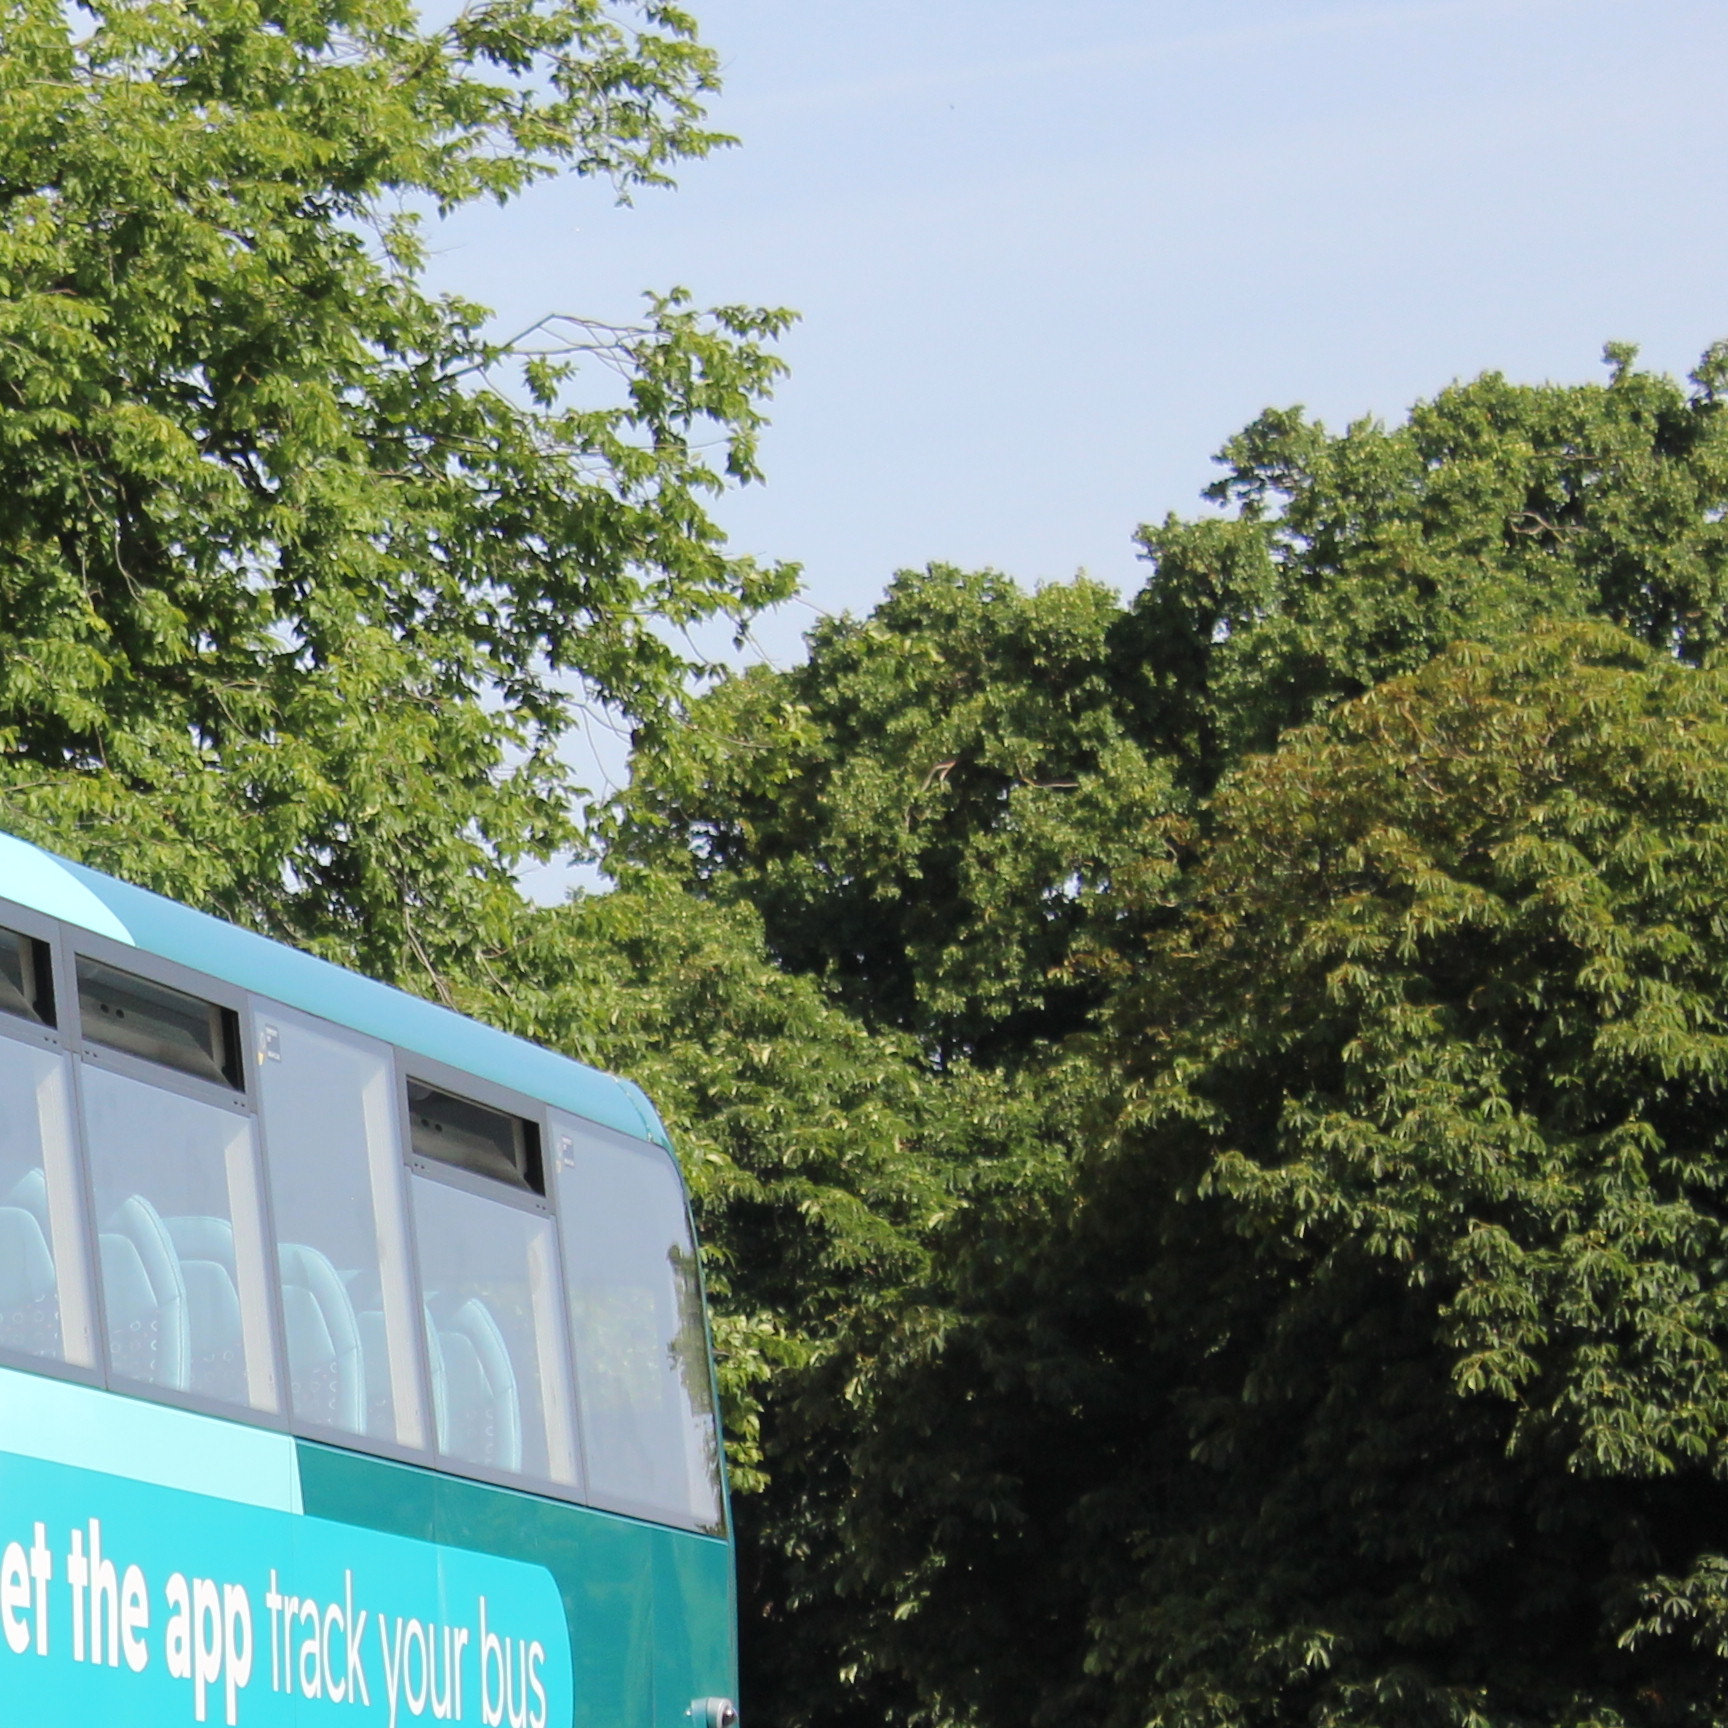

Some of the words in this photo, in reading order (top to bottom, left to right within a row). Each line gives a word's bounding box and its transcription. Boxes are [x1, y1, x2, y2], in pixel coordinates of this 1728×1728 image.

[67, 1516, 150, 1674] the
[164, 1570, 255, 1727] app
[265, 1568, 371, 1708] track
